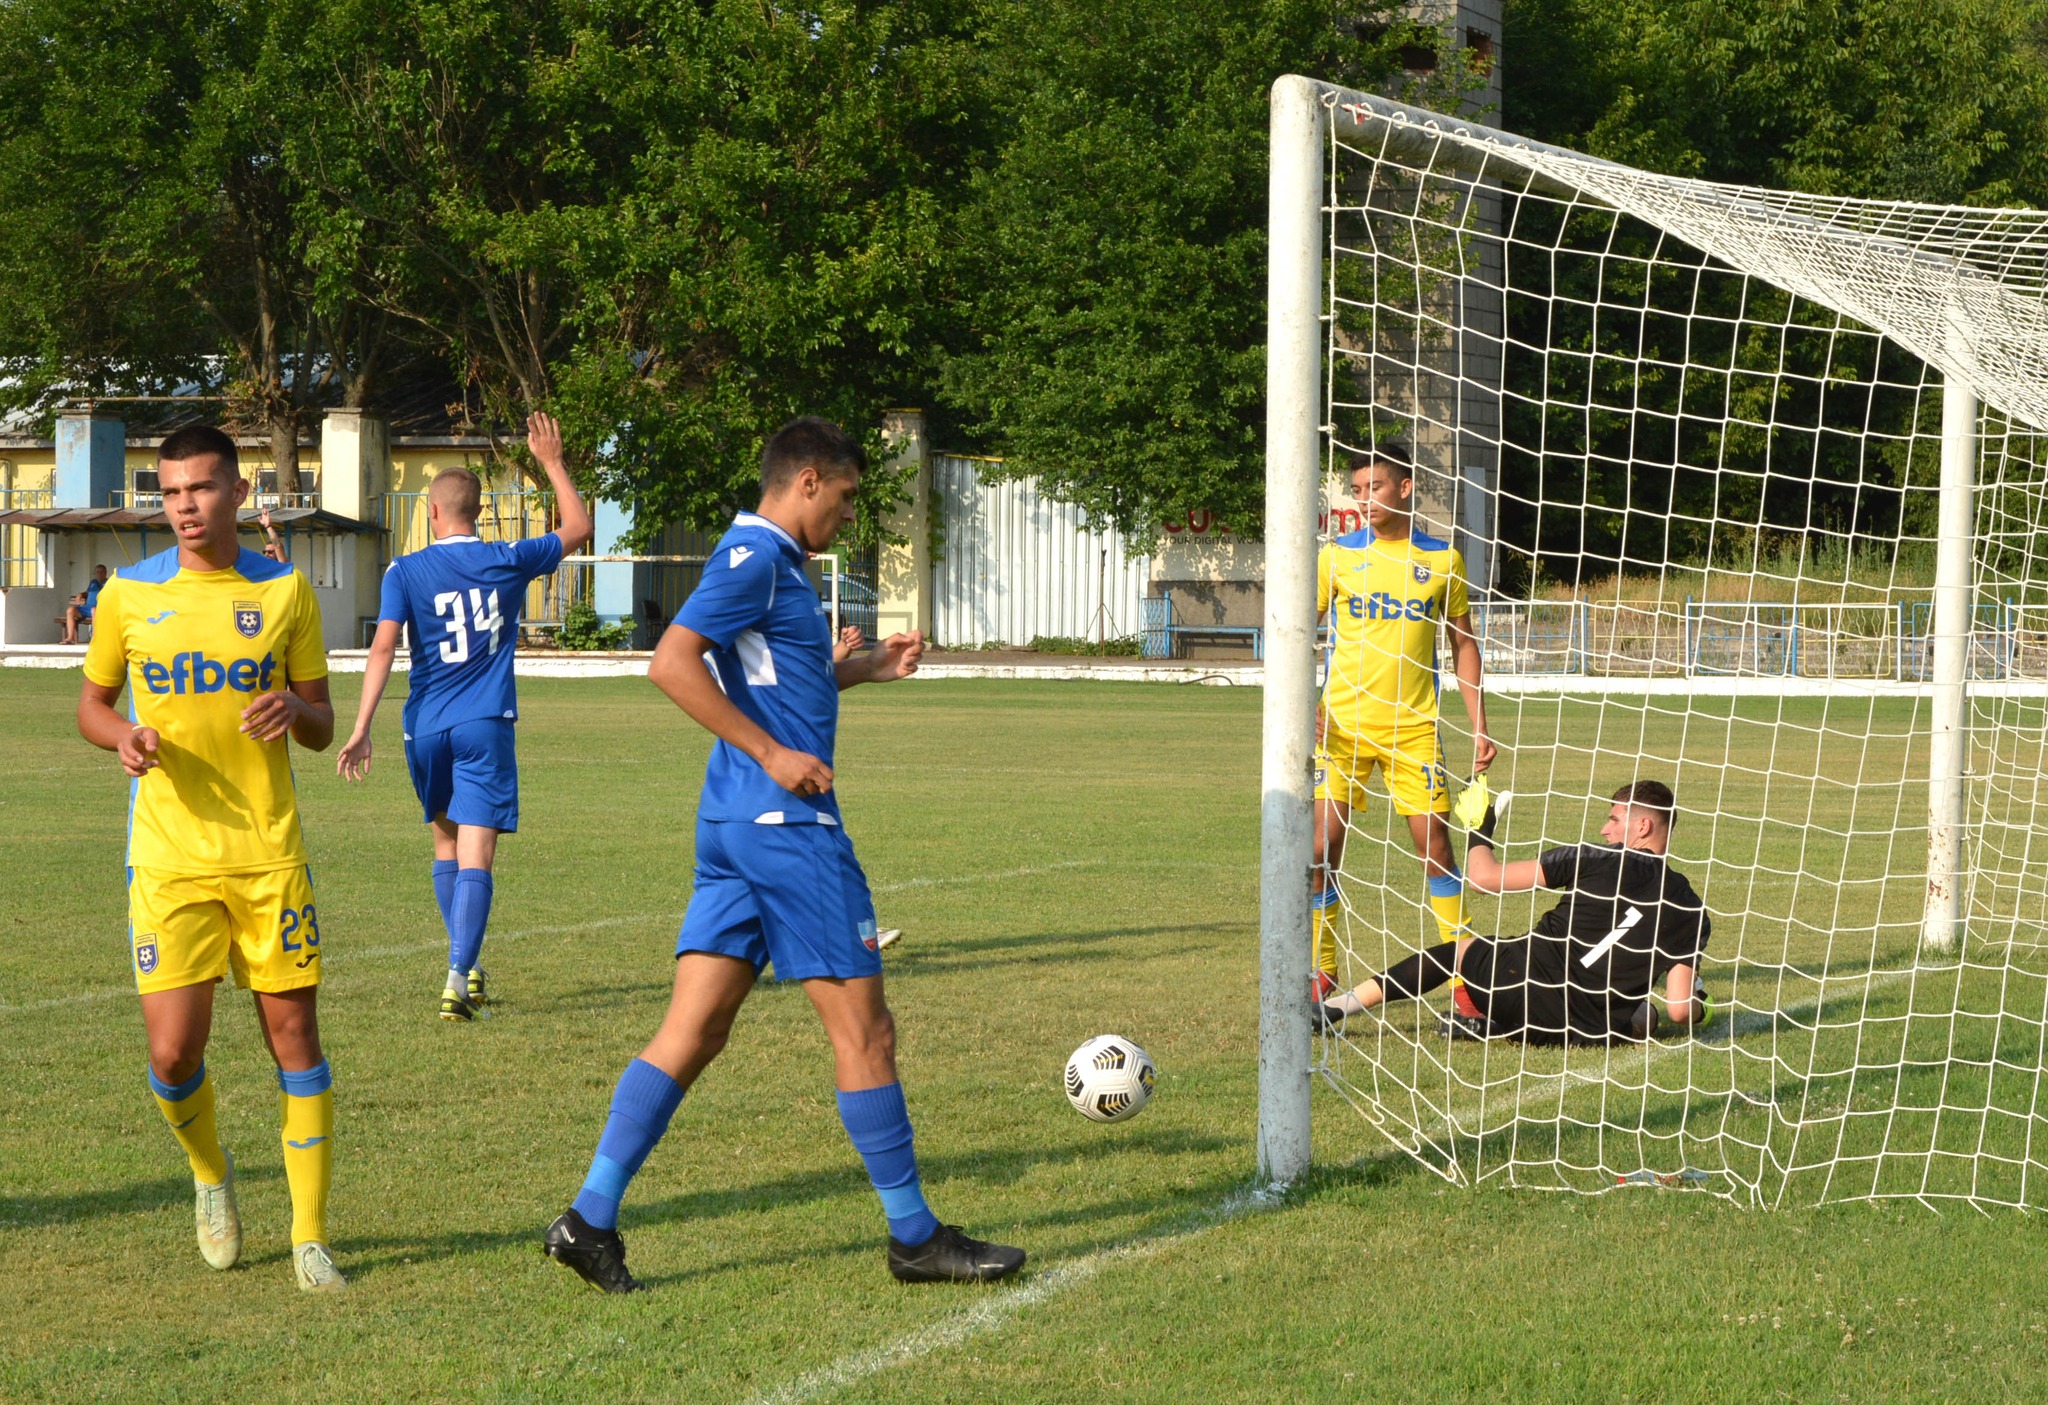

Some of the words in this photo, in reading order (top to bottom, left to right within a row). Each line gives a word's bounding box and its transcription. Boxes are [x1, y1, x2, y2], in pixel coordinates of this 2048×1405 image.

[1163, 536, 1191, 545] YOUR
[1194, 536, 1232, 545] DIGITAL
[434, 587, 505, 664] 34
[1348, 592, 1435, 622] efbet
[142, 651, 277, 695] efbet
[1421, 761, 1446, 790] 19
[280, 903, 321, 953] 23
[1579, 905, 1644, 969] 1
